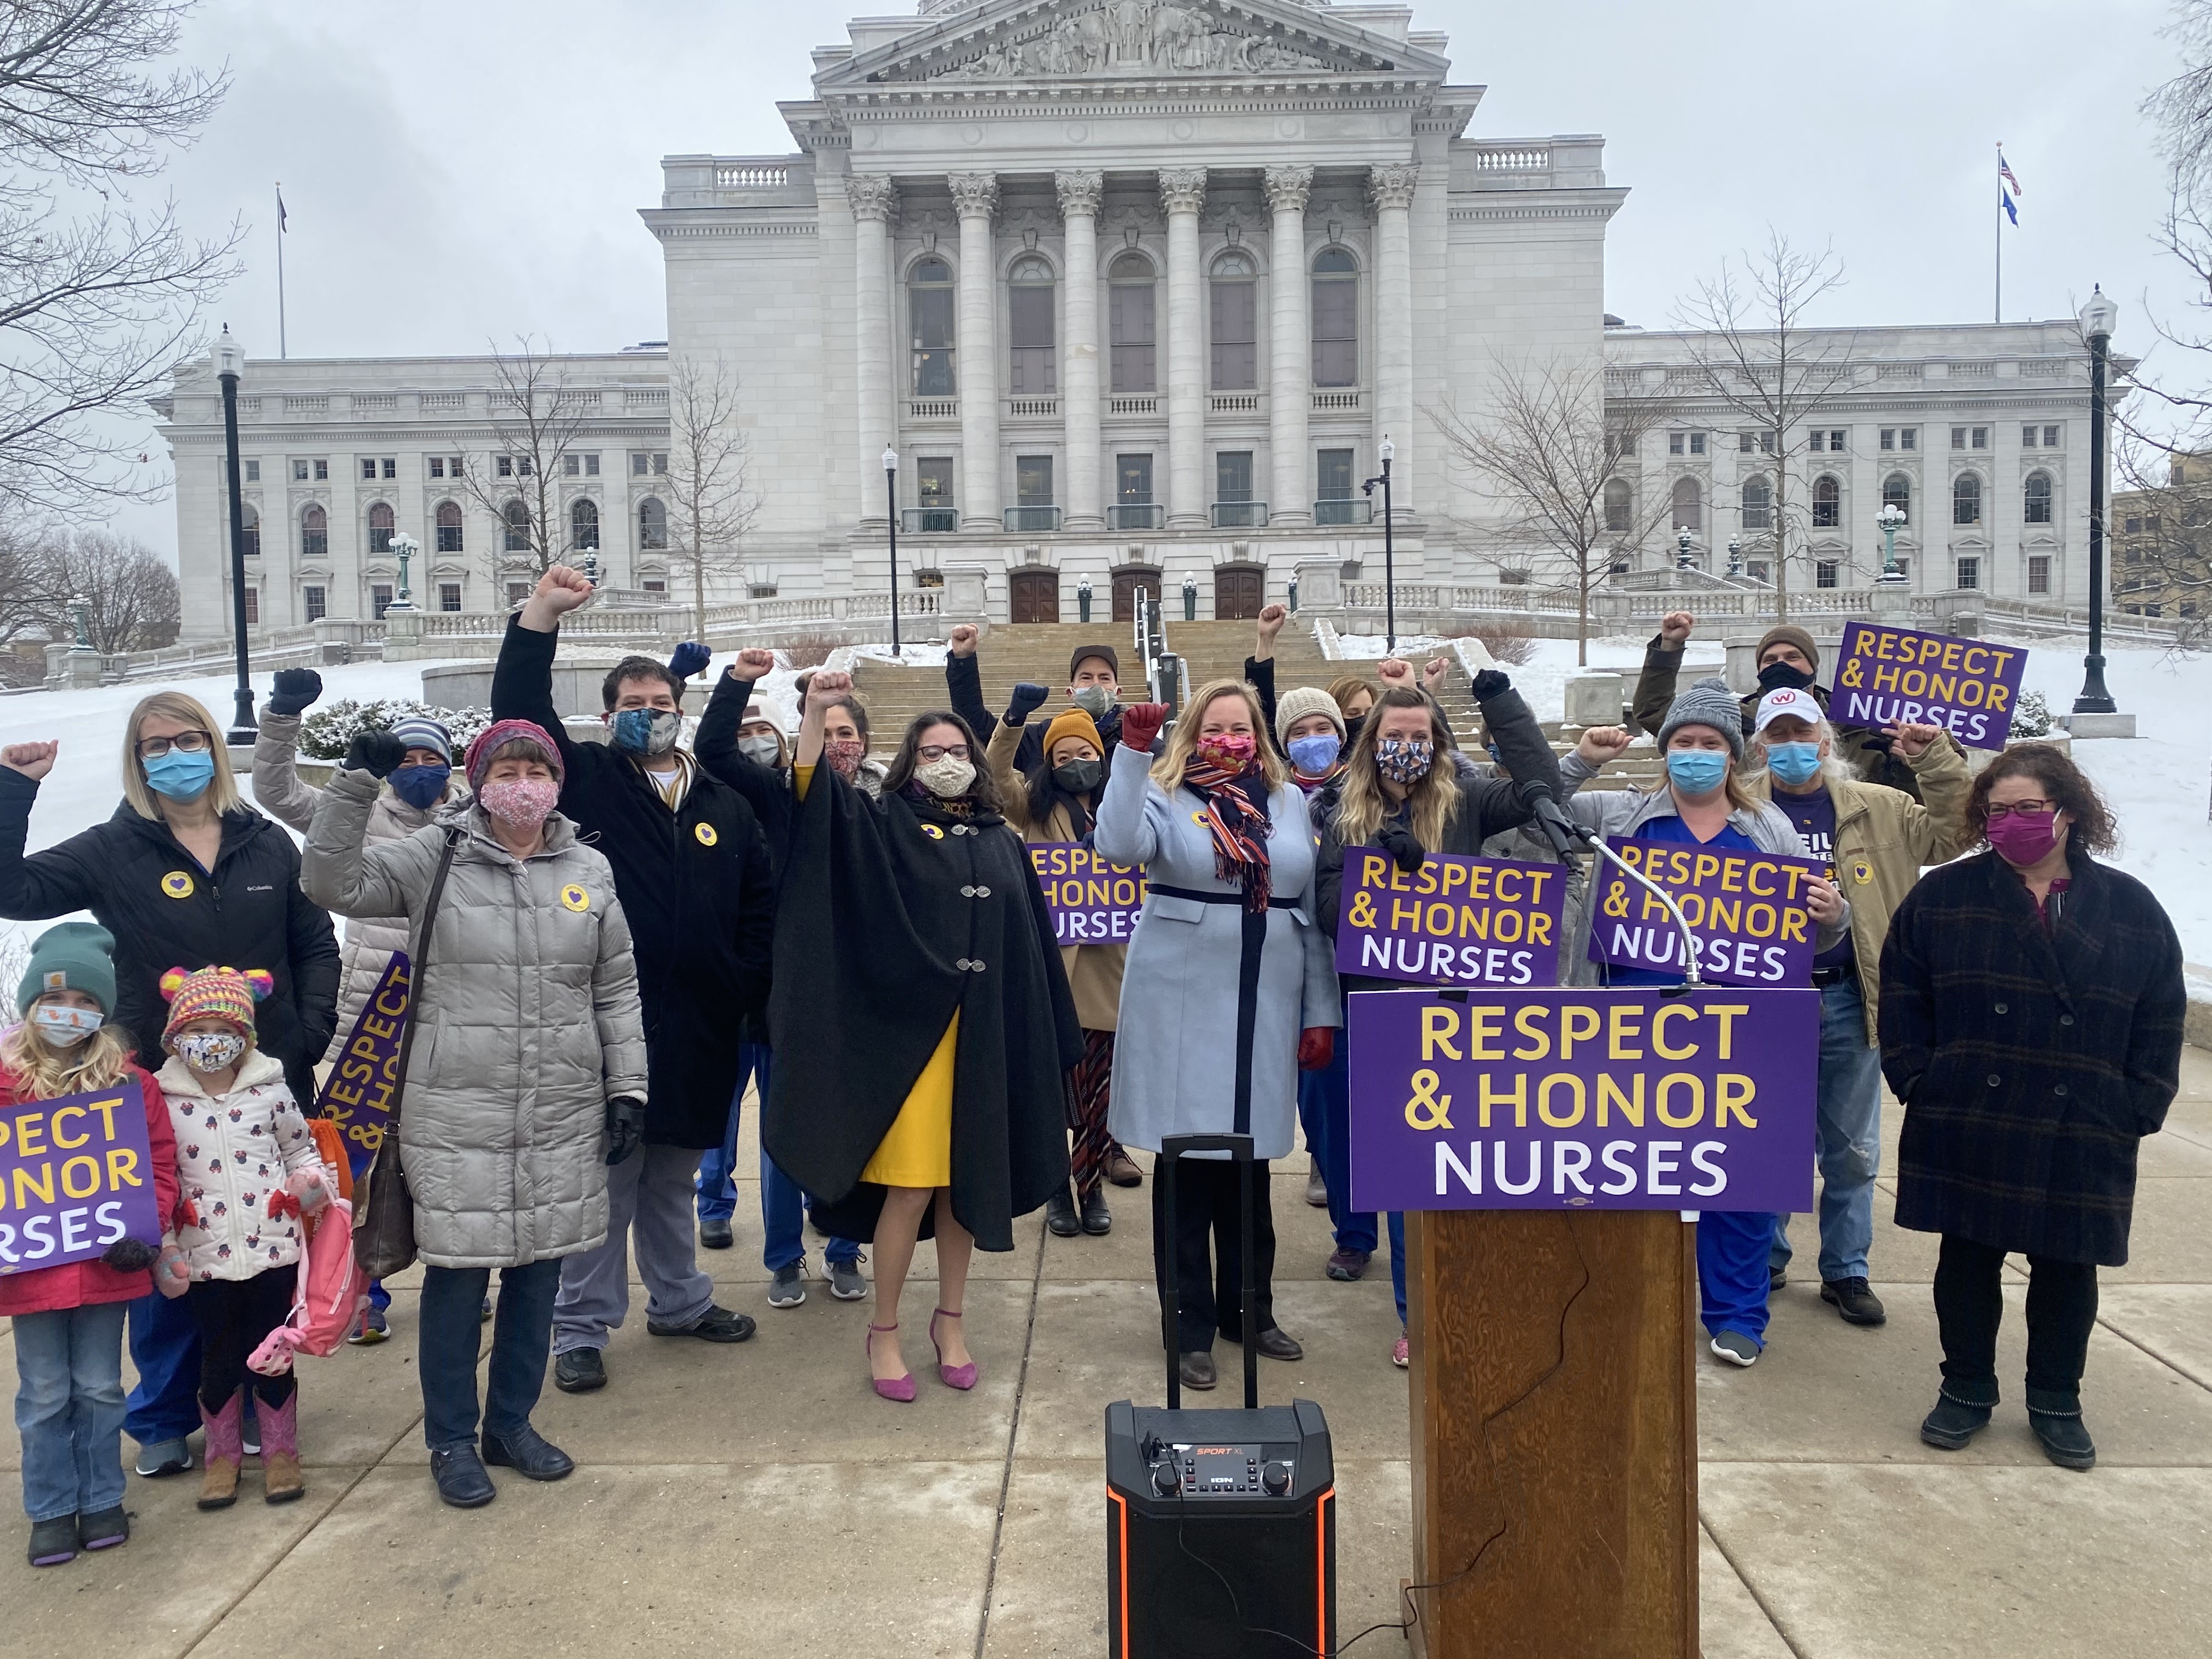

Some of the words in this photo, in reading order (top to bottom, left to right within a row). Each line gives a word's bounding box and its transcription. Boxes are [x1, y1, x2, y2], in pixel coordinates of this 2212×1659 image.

[1854, 629, 2014, 678] RESPECT
[1775, 693, 1791, 702] W
[1841, 658, 1864, 688] &
[1873, 664, 2009, 712] HONOR
[1848, 692, 1989, 741] NURSES
[1031, 849, 1146, 875] ESPE
[1362, 855, 1553, 904] RESPECT
[1618, 845, 1809, 900] RESPECT
[1348, 891, 1377, 928] &
[1391, 898, 1553, 946] HONOR
[1603, 881, 1630, 918] &
[1641, 889, 1808, 943] HONOR
[1362, 934, 1533, 985] NURSES
[1611, 924, 1787, 981] NURSES
[321, 966, 410, 1131] RESPECT
[1421, 1004, 1750, 1062] RESPECT
[1404, 1069, 1455, 1131] &
[1479, 1073, 1758, 1128] HONOR
[348, 1122, 386, 1150] &
[0, 1148, 143, 1211] NOR
[1435, 1140, 1728, 1196] NURSES
